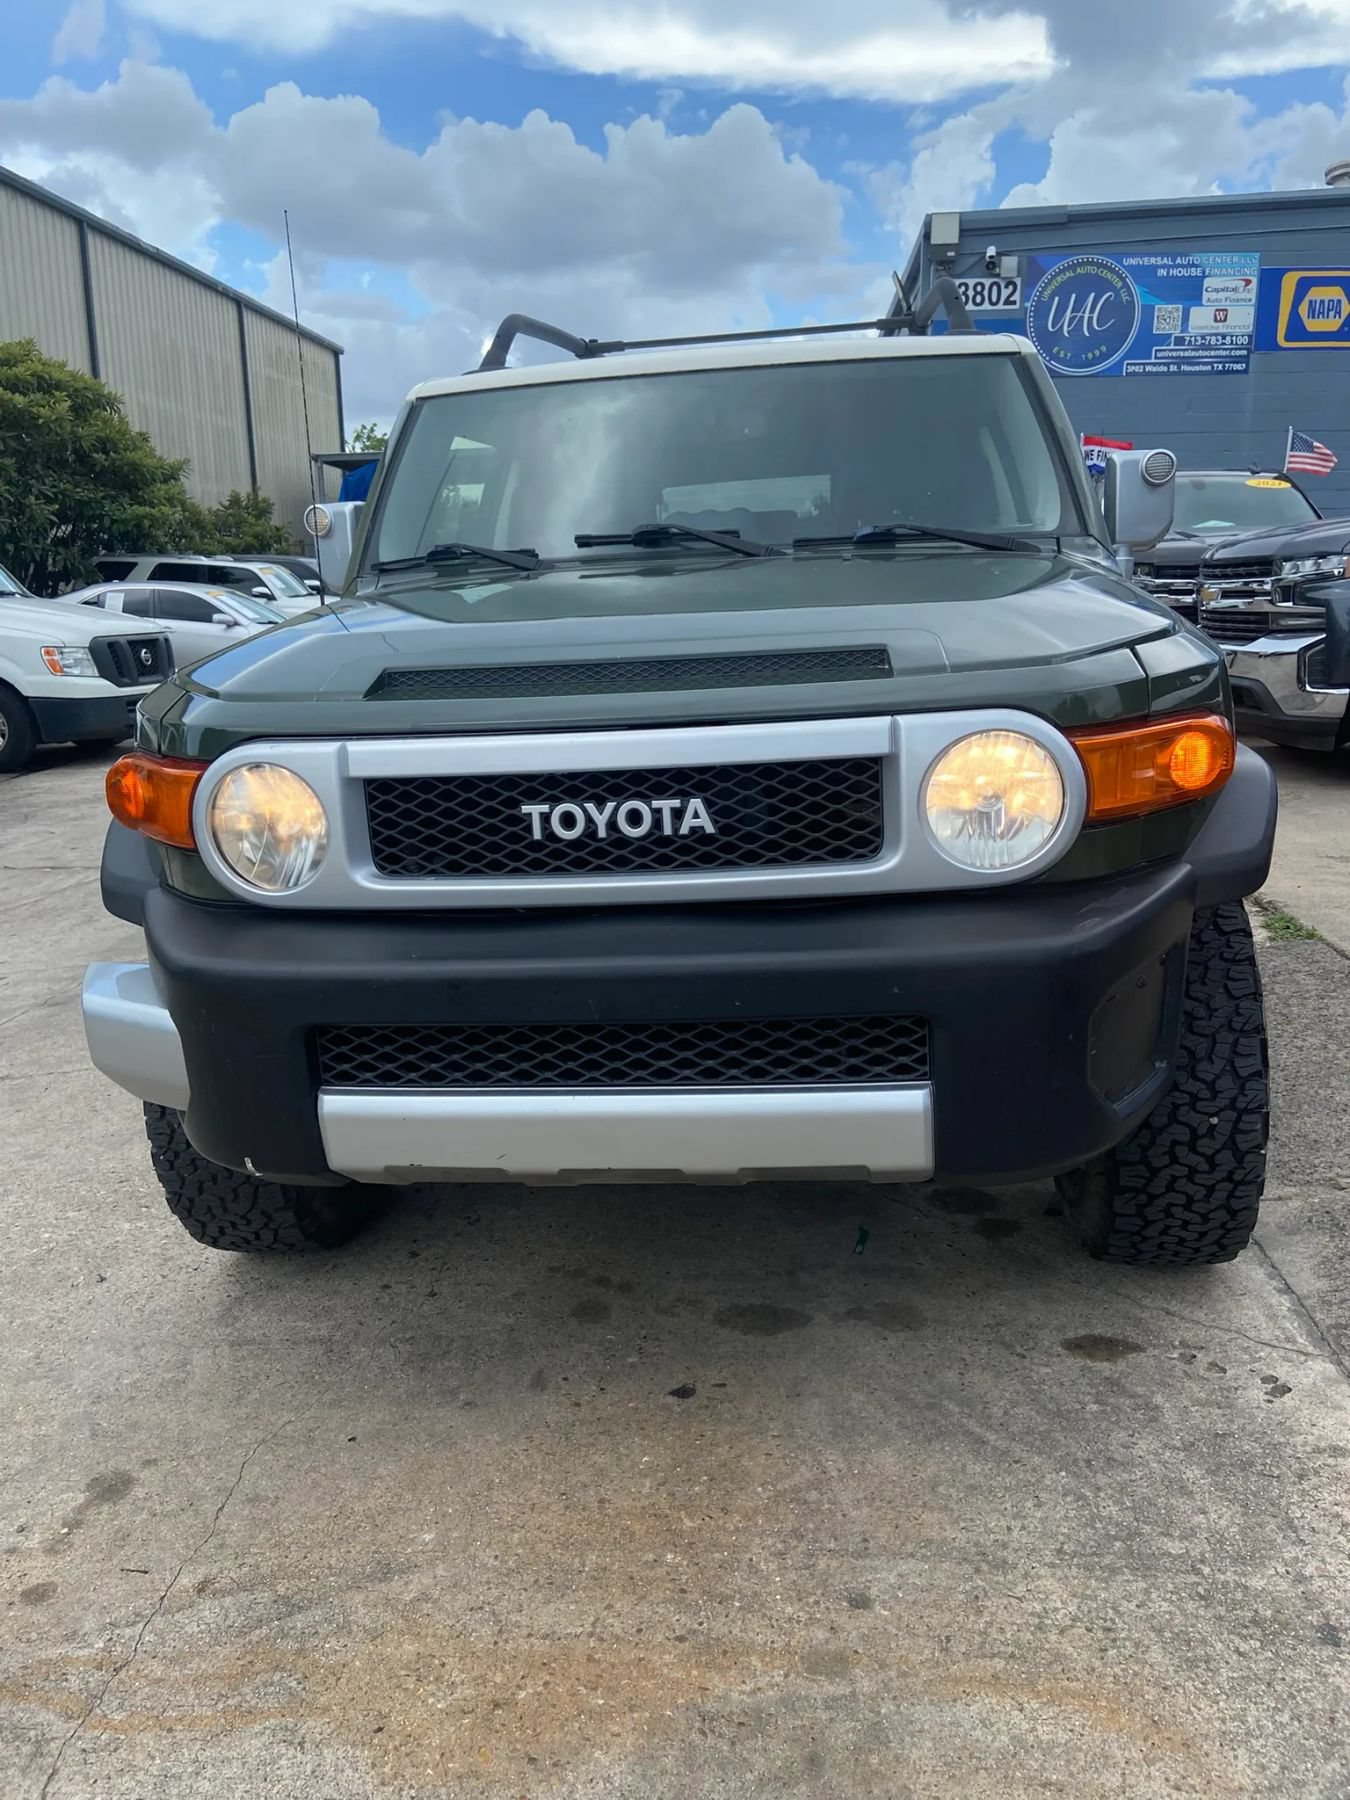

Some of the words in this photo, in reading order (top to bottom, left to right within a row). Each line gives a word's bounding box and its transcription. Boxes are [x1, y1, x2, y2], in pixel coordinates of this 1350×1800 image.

[1123, 257, 1173, 265] UNIVERSAL
[1175, 256, 1200, 265] AUTO
[1202, 255, 1239, 264] CENTER
[1241, 255, 1258, 264] LLC
[1157, 268, 1167, 277] IN
[1169, 267, 1203, 277] HOUSE
[1205, 266, 1257, 276] FINANCING
[1041, 270, 1075, 302] UNIVERSAL
[1076, 265, 1097, 275] AUTO
[1097, 267, 1124, 290] CENTER
[1120, 287, 1131, 305] LLC
[1204, 286, 1237, 294] Capital
[958, 280, 1018, 307] 3802
[1047, 292, 1115, 337] UAC
[1306, 298, 1343, 320] NAPA
[1215, 311, 1228, 321] W
[1184, 335, 1249, 346] 713-783-8100
[1081, 345, 1107, 361] 1999
[1156, 349, 1248, 358] universalautocenter.com
[1180, 362, 1212, 372] Houston
[1213, 362, 1223, 371] TX
[520, 797, 716, 842] TOYOTA
